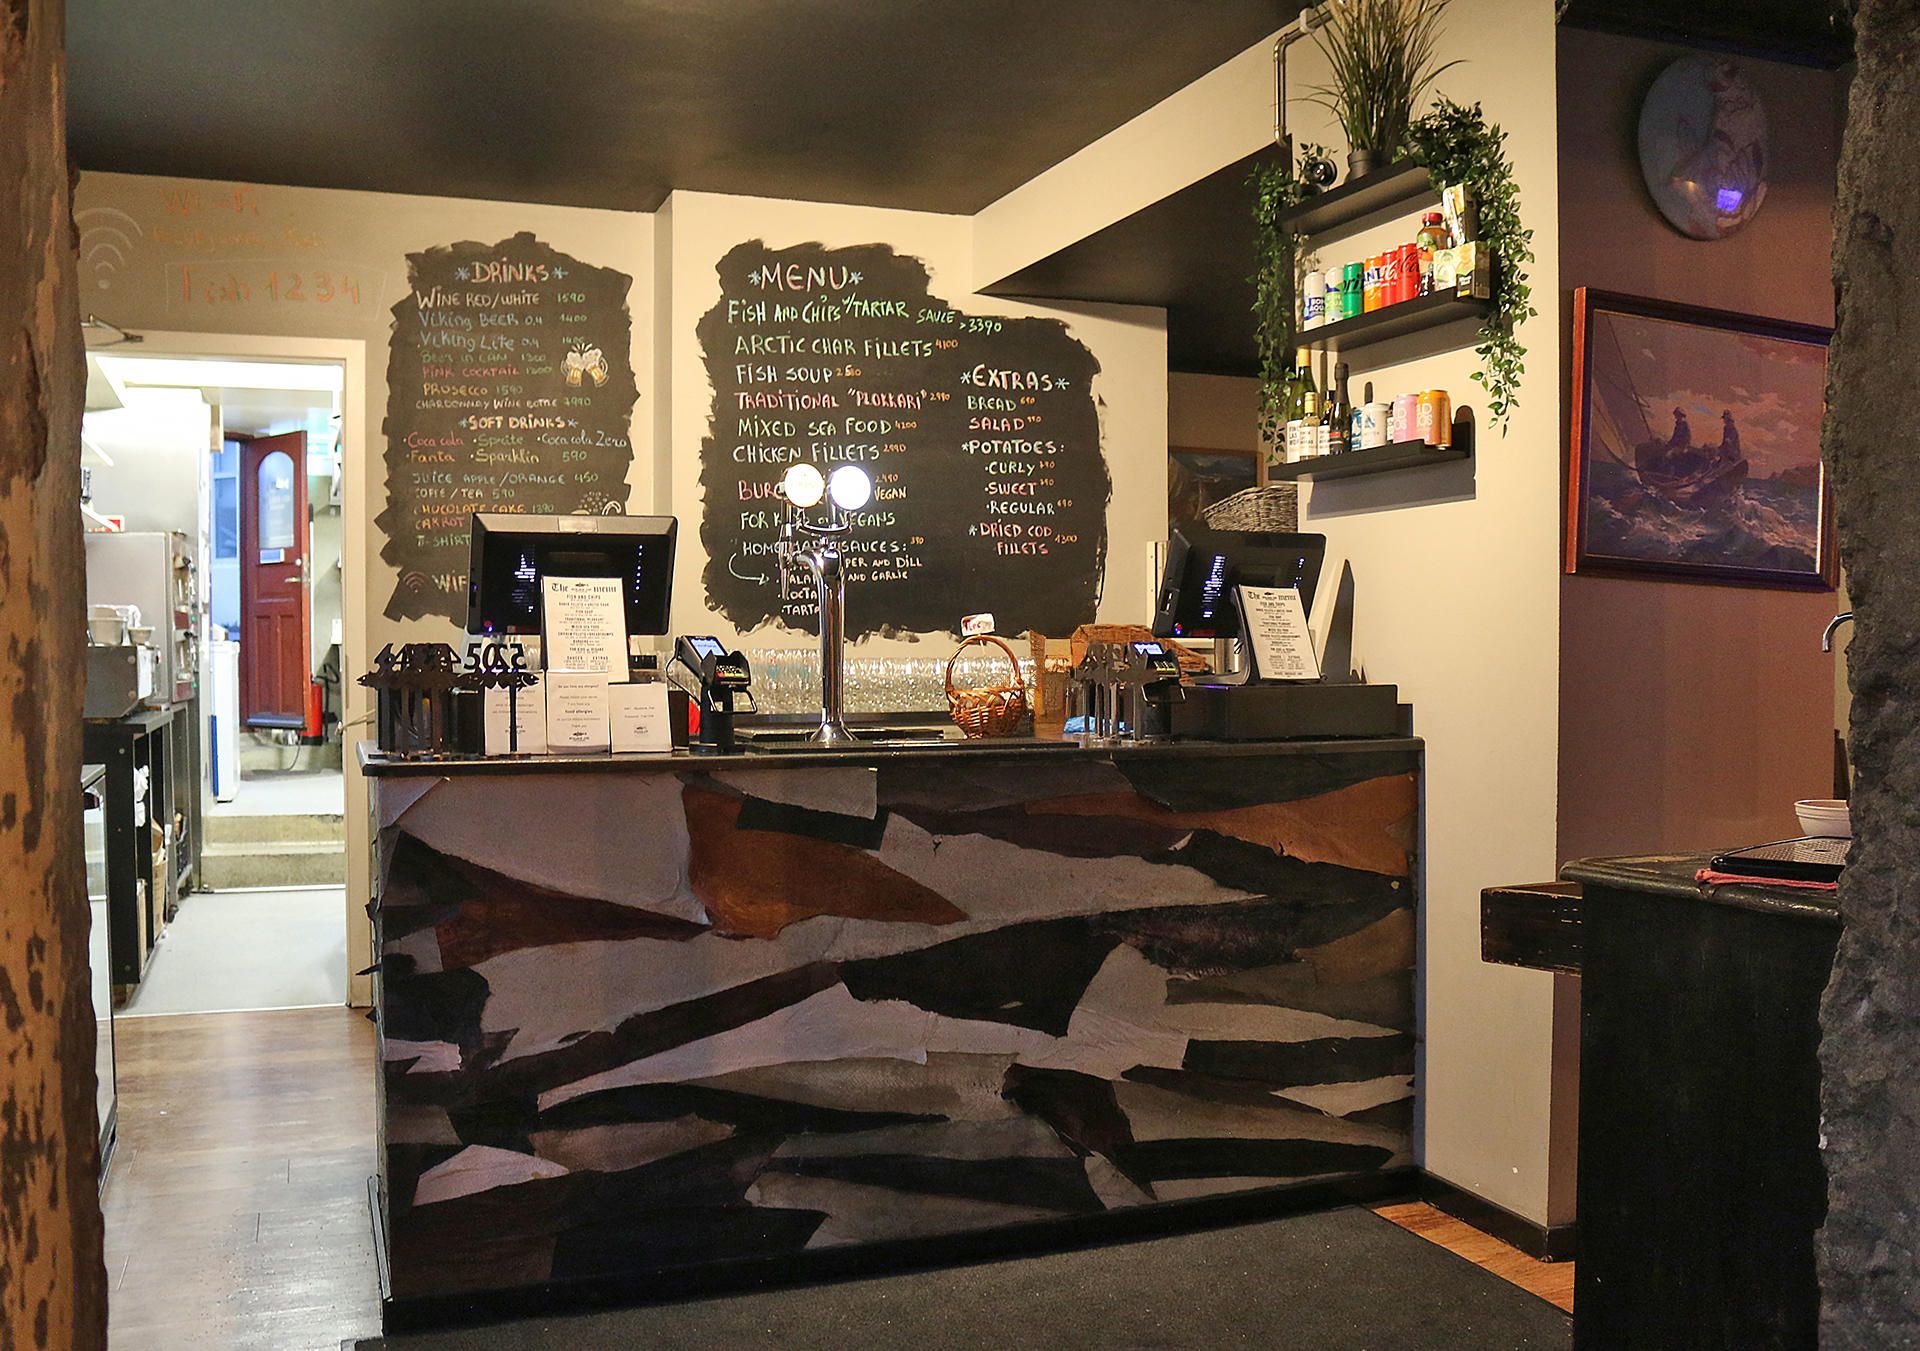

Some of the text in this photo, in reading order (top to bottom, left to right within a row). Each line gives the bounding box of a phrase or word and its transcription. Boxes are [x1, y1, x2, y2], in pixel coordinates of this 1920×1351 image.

[470, 256, 550, 284] DRINKS
[760, 261, 849, 293] MENU
[415, 285, 461, 310] WINE
[555, 291, 587, 304] 1590
[727, 298, 767, 325] FISH
[773, 302, 799, 324] AND
[801, 294, 842, 324] CHIPS
[915, 308, 956, 325] SAUCE
[417, 310, 473, 332] Viking
[524, 314, 543, 326] 0.4
[558, 312, 588, 324] 1400
[419, 330, 476, 351] Viking
[520, 337, 540, 349] 0.4
[734, 330, 959, 360] ARCTIC CHAR FILLETS 4100
[735, 362, 778, 385] FISH
[785, 364, 834, 384] SOUP
[971, 363, 1053, 393] EXTRAS
[422, 382, 523, 397] PROSECCO 1590
[415, 397, 491, 411] CHARDONNAY
[492, 395, 522, 411] WINE
[733, 387, 840, 412] TRADITIONAL
[966, 395, 1036, 412] BREAD 690
[468, 414, 567, 431] SOFT DRINKS
[737, 414, 797, 439] MIXED
[806, 420, 837, 437] SEA
[844, 416, 893, 436] FOOD
[968, 415, 1025, 432] SALAD
[410, 450, 457, 464] Fanta
[561, 450, 588, 463] 590
[732, 442, 802, 464] CHICKEN
[810, 441, 881, 464] FILLETS
[987, 460, 1037, 477] CURLY
[411, 470, 453, 485] JUICE
[462, 474, 496, 485] APPLE
[573, 472, 599, 484] 450
[460, 487, 484, 500] TEA
[491, 487, 516, 500] 590
[873, 486, 908, 502] VEGAN
[987, 481, 1038, 496] SWEET
[490, 503, 528, 515] CAKE
[989, 500, 1056, 516] REGULAR
[414, 515, 467, 531] CARROT
[739, 511, 769, 531] FOR
[838, 511, 897, 529] VEGANS
[979, 518, 1023, 539] DRIED
[1026, 525, 1053, 539] COD
[996, 541, 1050, 556] FILLETS
[871, 557, 892, 568] AND
[895, 553, 924, 569] DILL
[847, 573, 868, 583] AND
[870, 570, 909, 582] GARLIC
